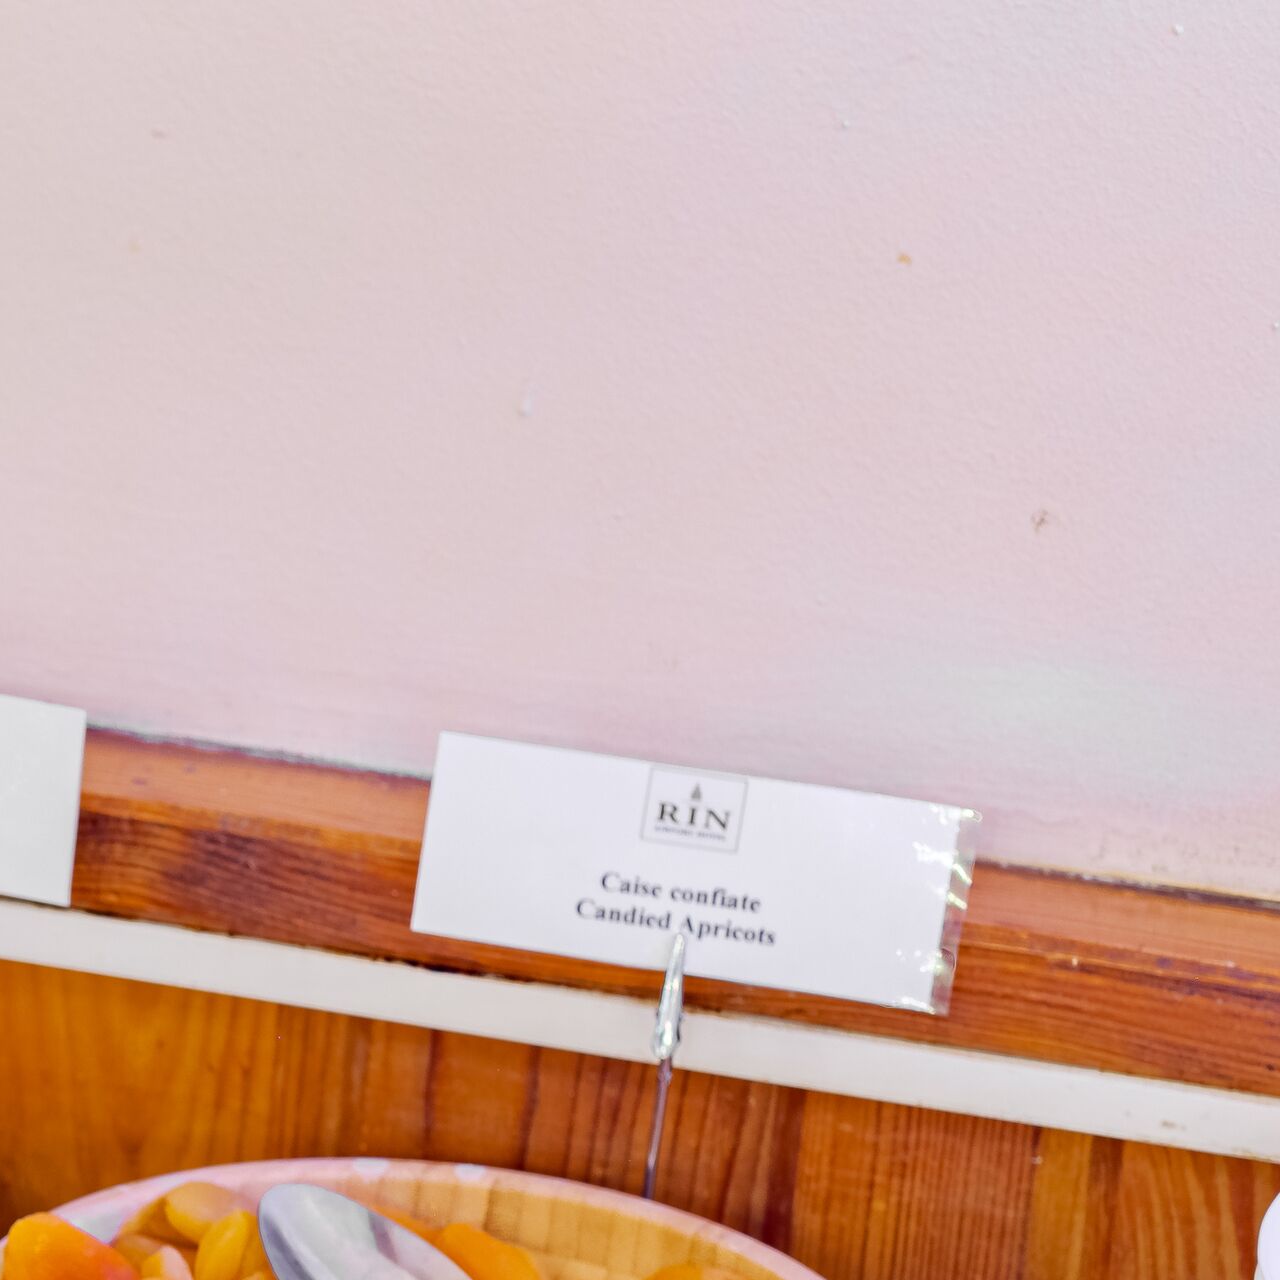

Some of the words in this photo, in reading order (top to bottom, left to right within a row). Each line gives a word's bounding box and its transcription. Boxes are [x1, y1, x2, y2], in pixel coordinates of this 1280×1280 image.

[658, 801, 731, 831] RIN
[601, 871, 662, 898] Caise
[670, 887, 761, 914] confiate
[576, 898, 671, 930] Candied
[681, 916, 776, 945] Apricots
